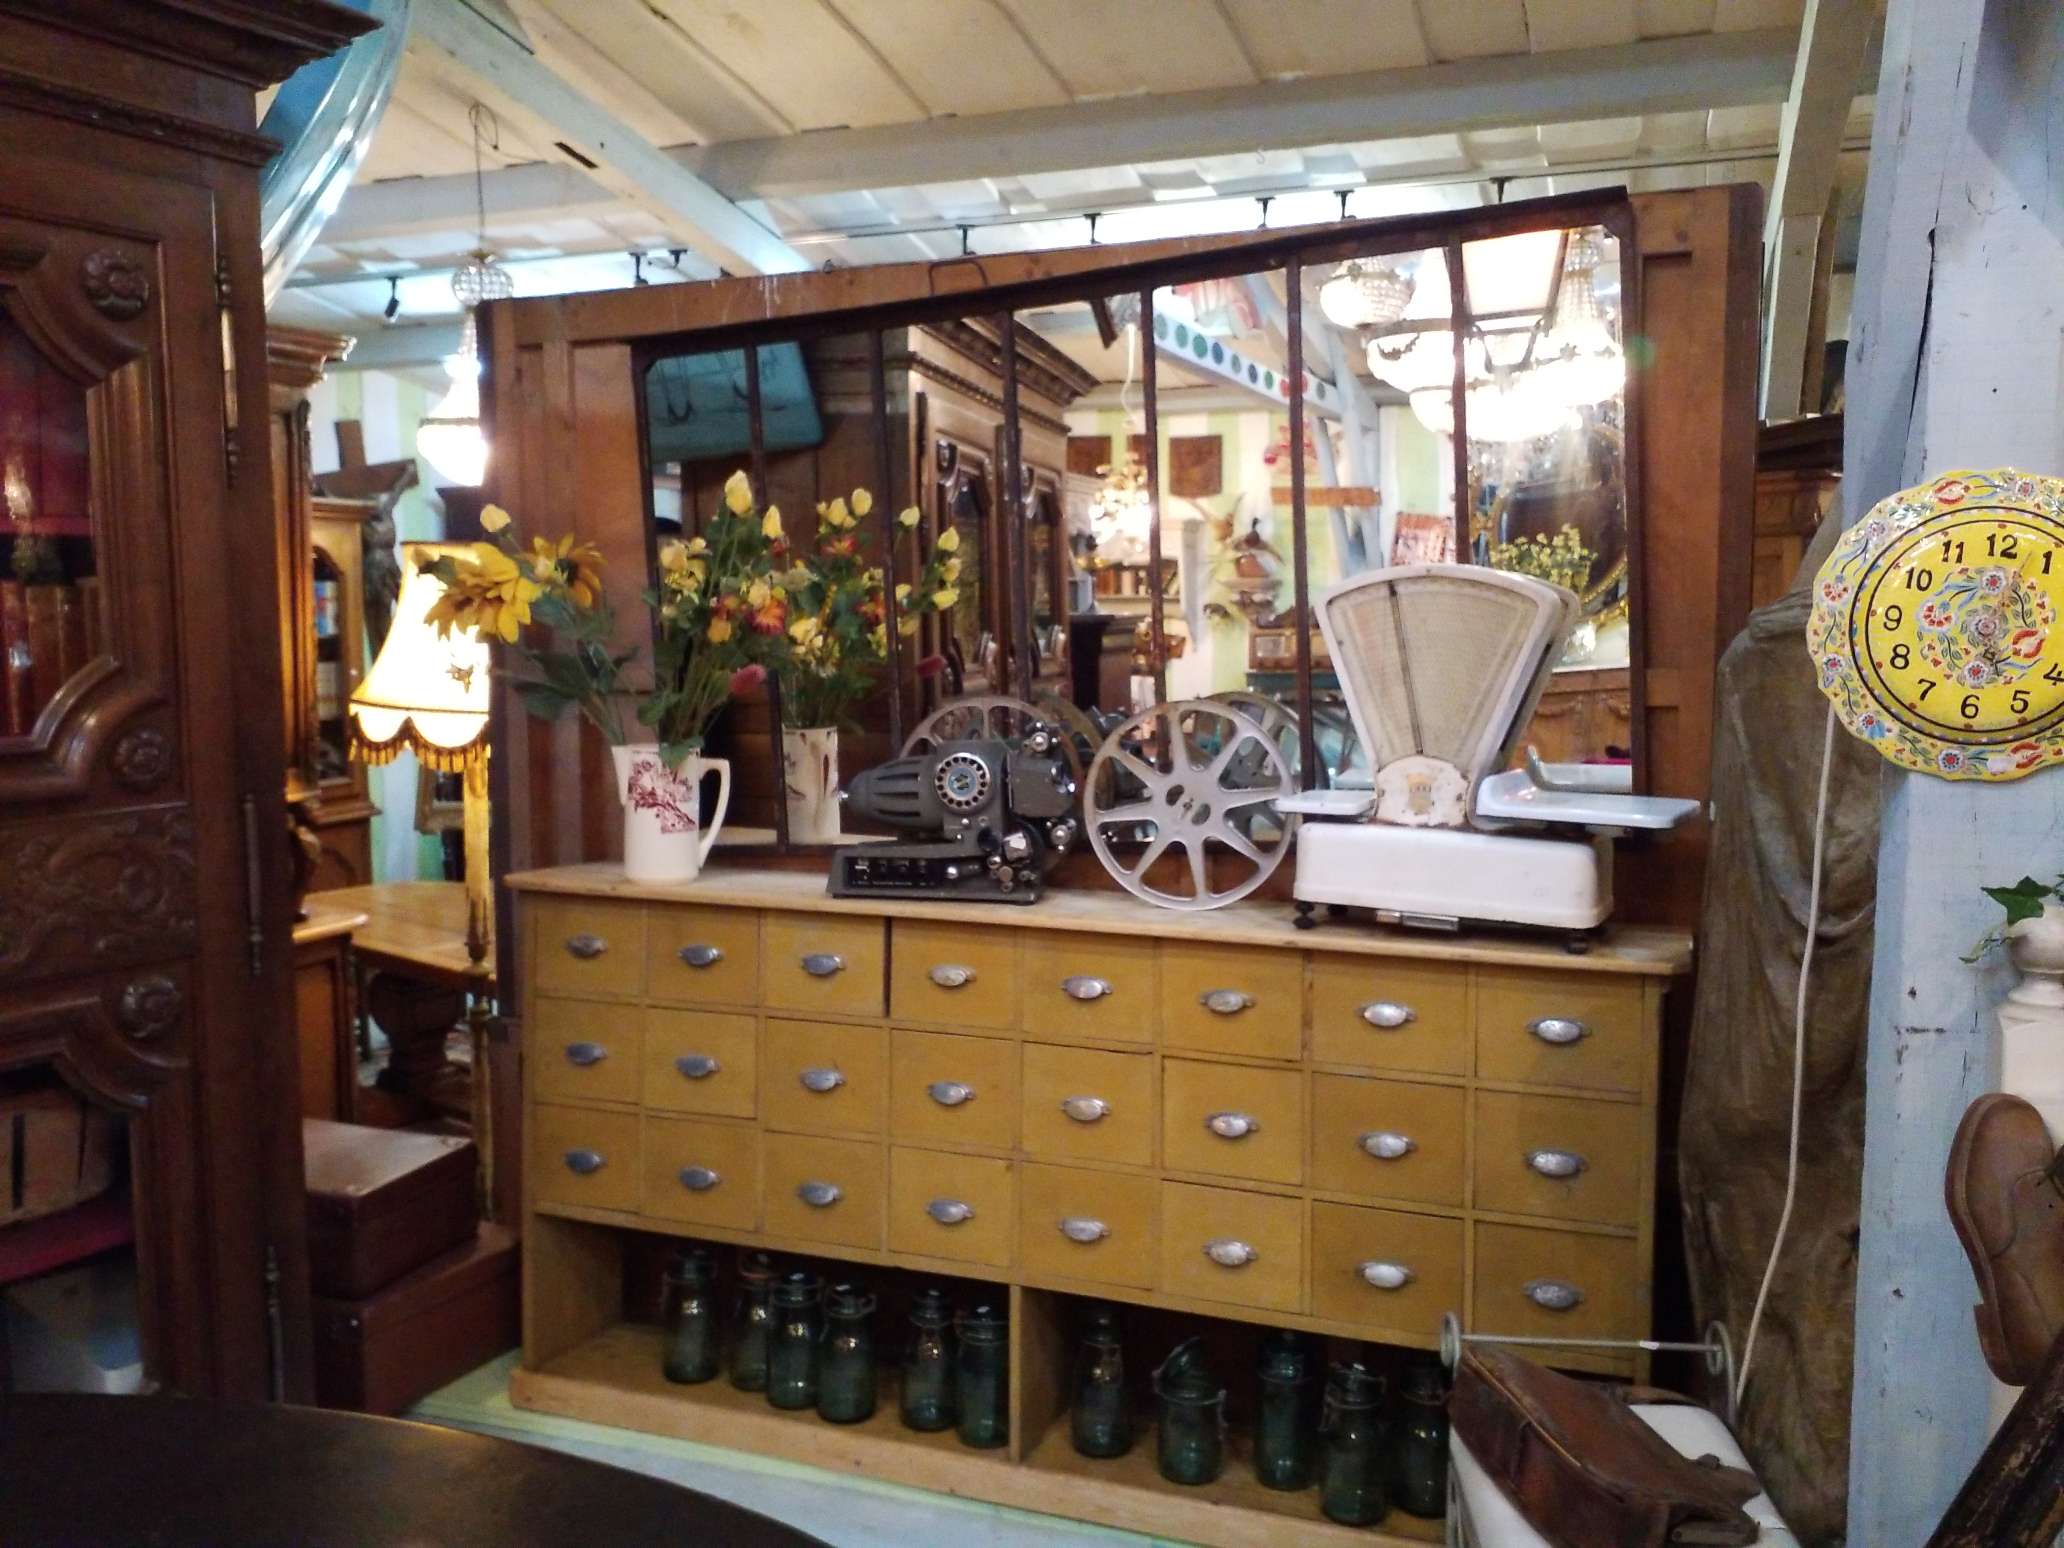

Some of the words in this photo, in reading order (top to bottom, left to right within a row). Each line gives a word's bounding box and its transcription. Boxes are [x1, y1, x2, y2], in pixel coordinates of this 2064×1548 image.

[1942, 539, 1965, 564] 11
[1986, 533, 2018, 560] 12
[2041, 550, 2053, 575] 1
[1905, 567, 1933, 592] 10
[1883, 604, 1903, 631] 9
[1889, 643, 1910, 670] 8
[2043, 662, 2064, 686] 4
[1917, 678, 1937, 701] 7
[2010, 689, 2031, 714] 5
[1960, 694, 1980, 720] 6
